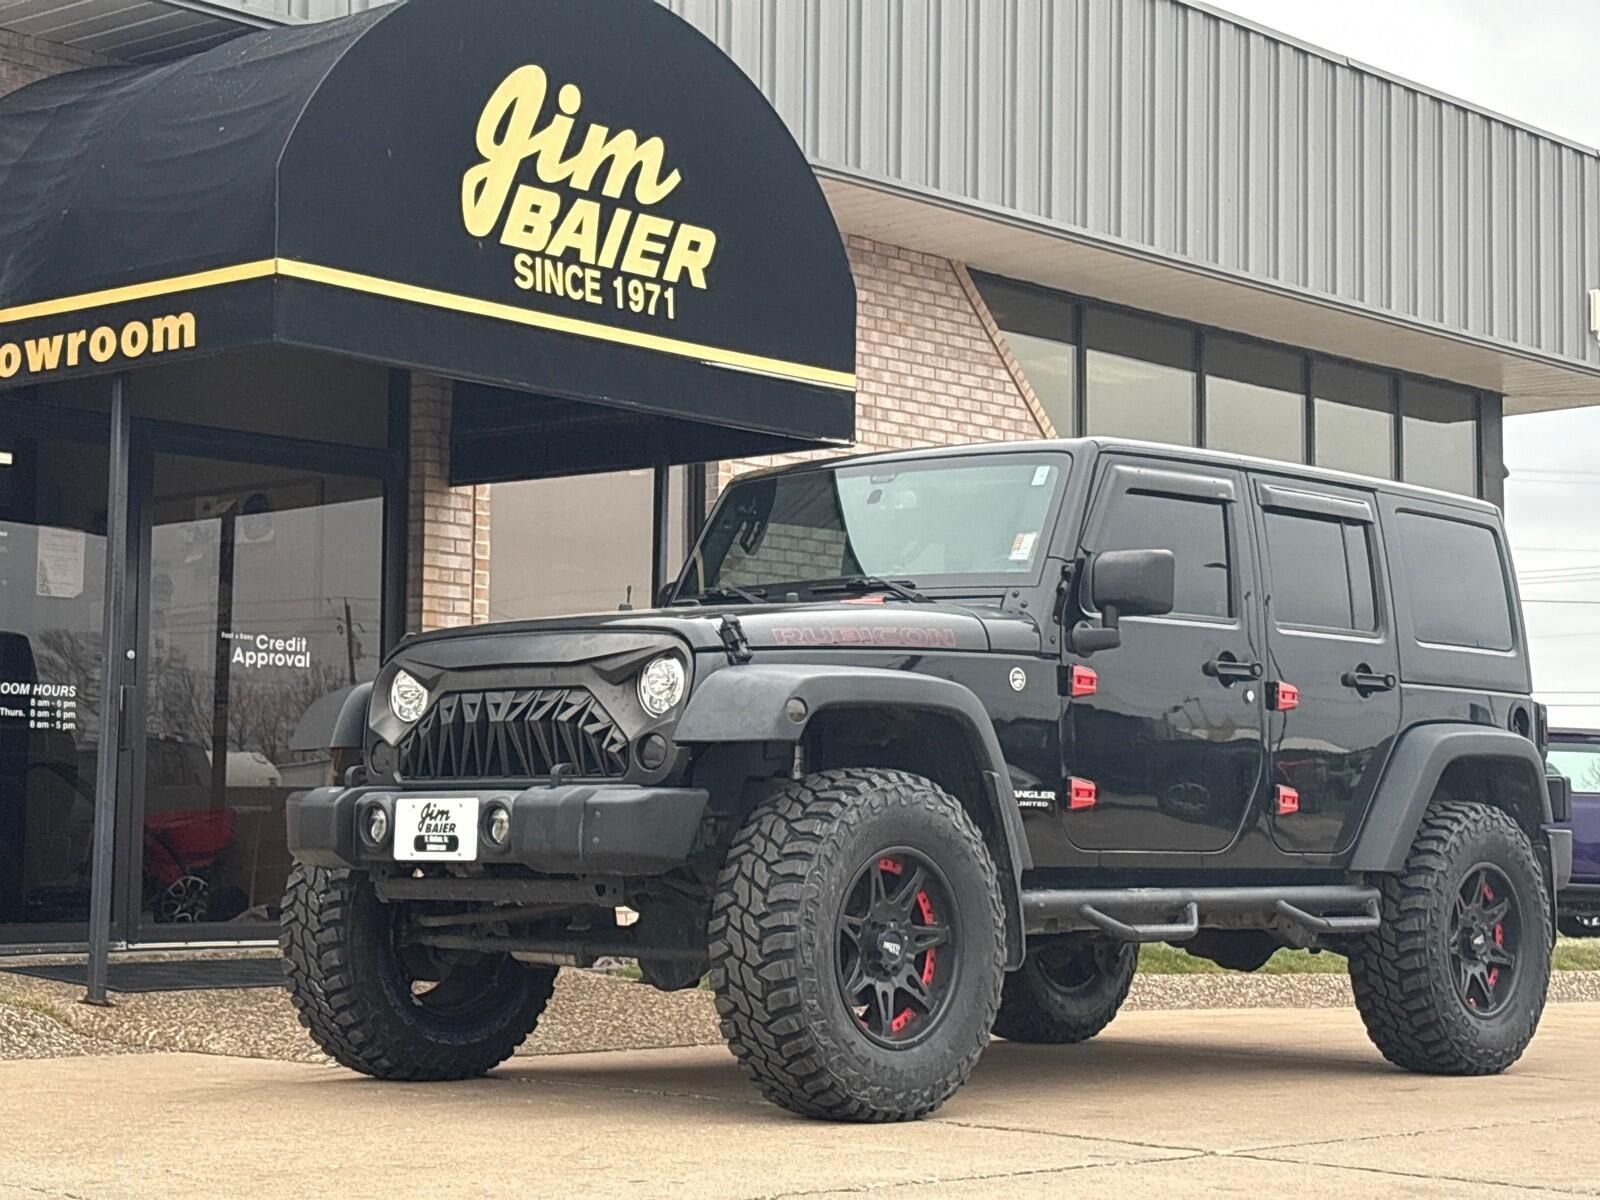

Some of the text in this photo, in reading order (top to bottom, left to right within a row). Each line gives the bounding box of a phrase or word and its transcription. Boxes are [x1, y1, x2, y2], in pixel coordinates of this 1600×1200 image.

[462, 64, 682, 237] Jim
[500, 184, 716, 289] BAIER
[514, 253, 674, 319] SINCE 1971
[0, 312, 196, 378] owroom
[256, 634, 307, 652] Credit
[772, 627, 956, 647] RUBICON
[232, 646, 310, 668] Approval
[0, 682, 77, 697] OOM HOURS
[63, 701, 76, 710] pm
[63, 712, 76, 720] pm
[62, 723, 76, 731] pm
[418, 802, 451, 832] Jim
[425, 823, 456, 833] BAIER
